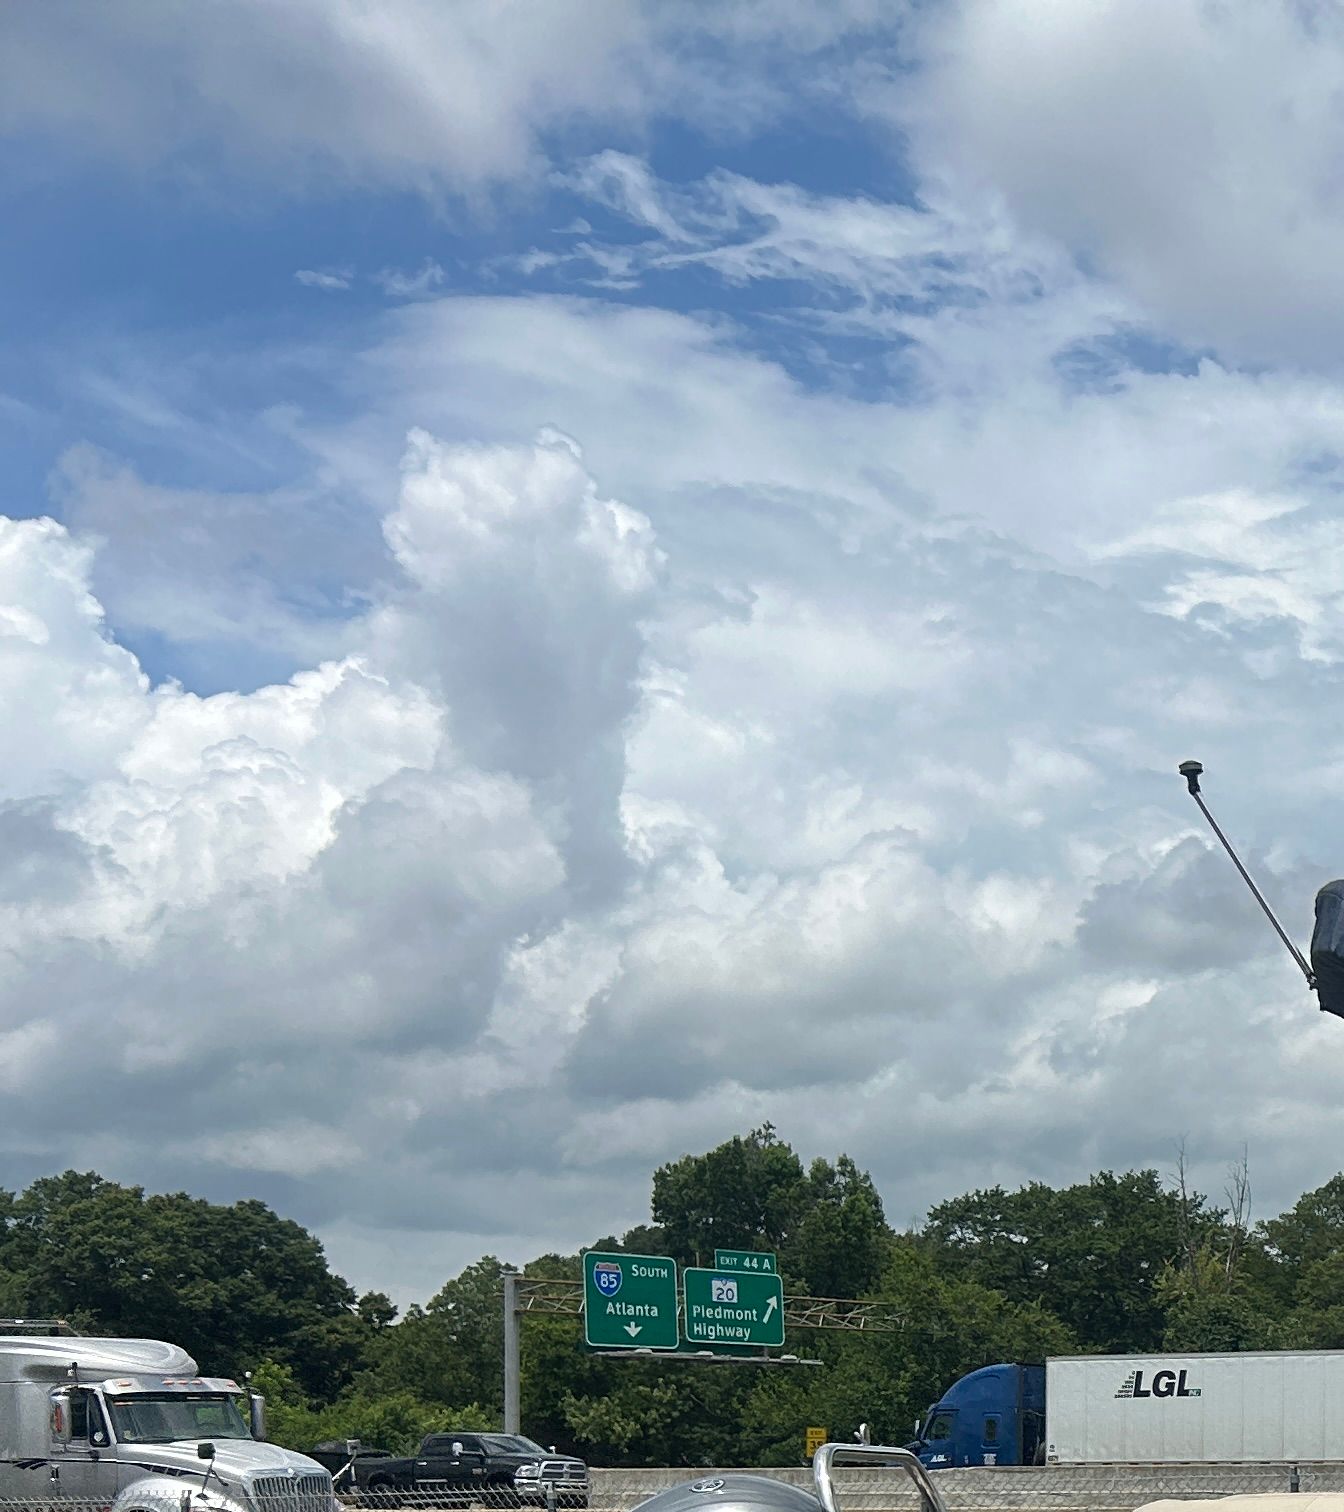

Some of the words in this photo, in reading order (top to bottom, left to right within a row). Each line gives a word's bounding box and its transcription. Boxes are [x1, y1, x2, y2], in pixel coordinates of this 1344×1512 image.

[720, 1256, 737, 1266] EXIT
[743, 1256, 758, 1269] 44
[762, 1258, 771, 1270] A
[631, 1264, 668, 1279] SOUTH
[600, 1273, 617, 1288] 85
[716, 1287, 735, 1301] 20
[606, 1302, 659, 1317] Atlanta
[692, 1304, 758, 1322] Piedmont
[693, 1322, 751, 1341] Highway
[1133, 1369, 1189, 1398] LGL
